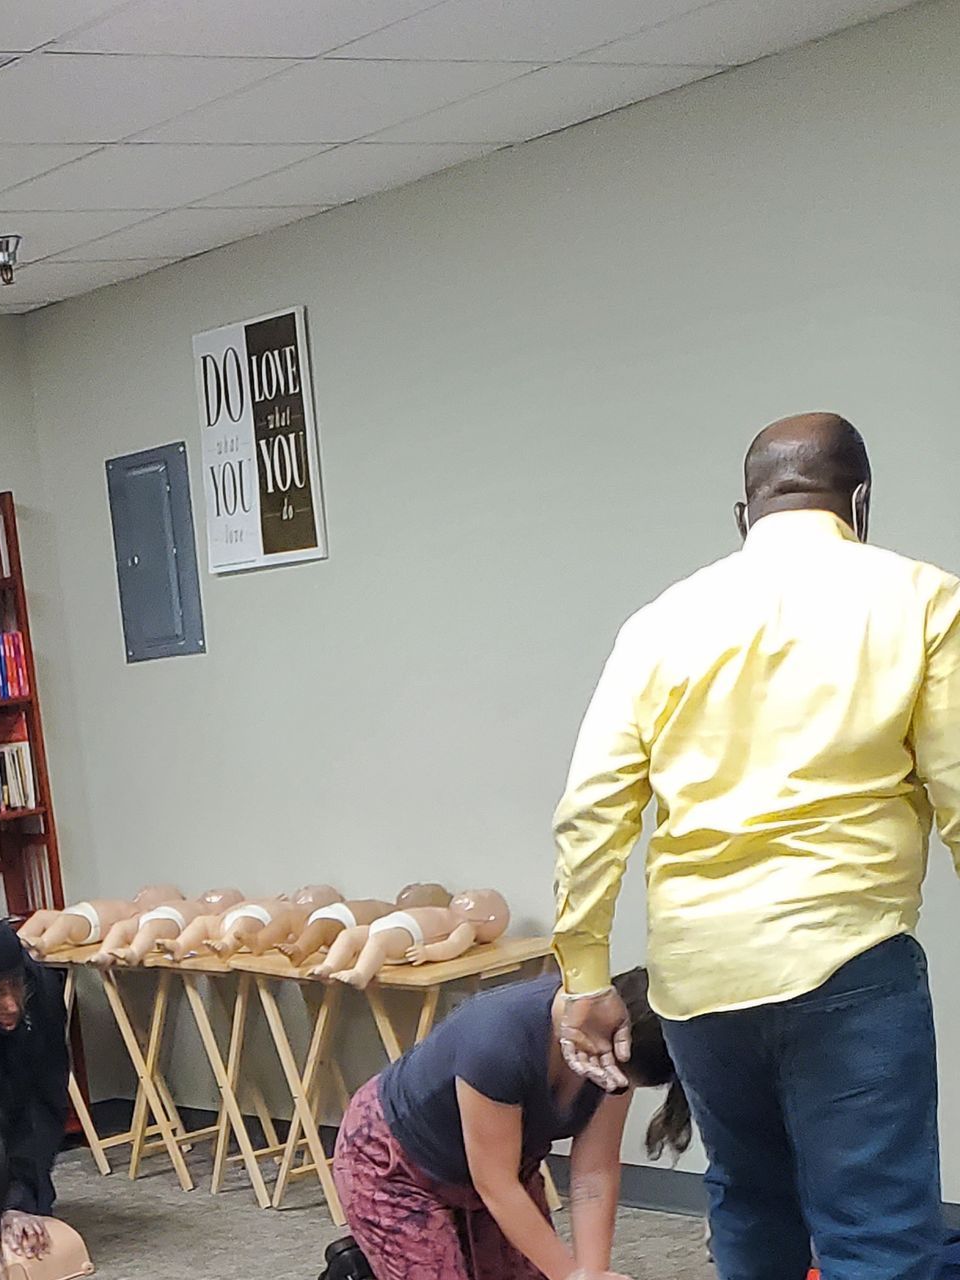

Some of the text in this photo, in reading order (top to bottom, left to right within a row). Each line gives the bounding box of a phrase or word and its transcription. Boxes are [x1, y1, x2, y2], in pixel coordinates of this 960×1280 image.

[201, 347, 244, 427] DO
[251, 345, 300, 402] LOVE
[267, 406, 291, 430] what
[209, 458, 253, 517] YOU
[259, 432, 306, 493] YOU
[282, 497, 294, 520] do
